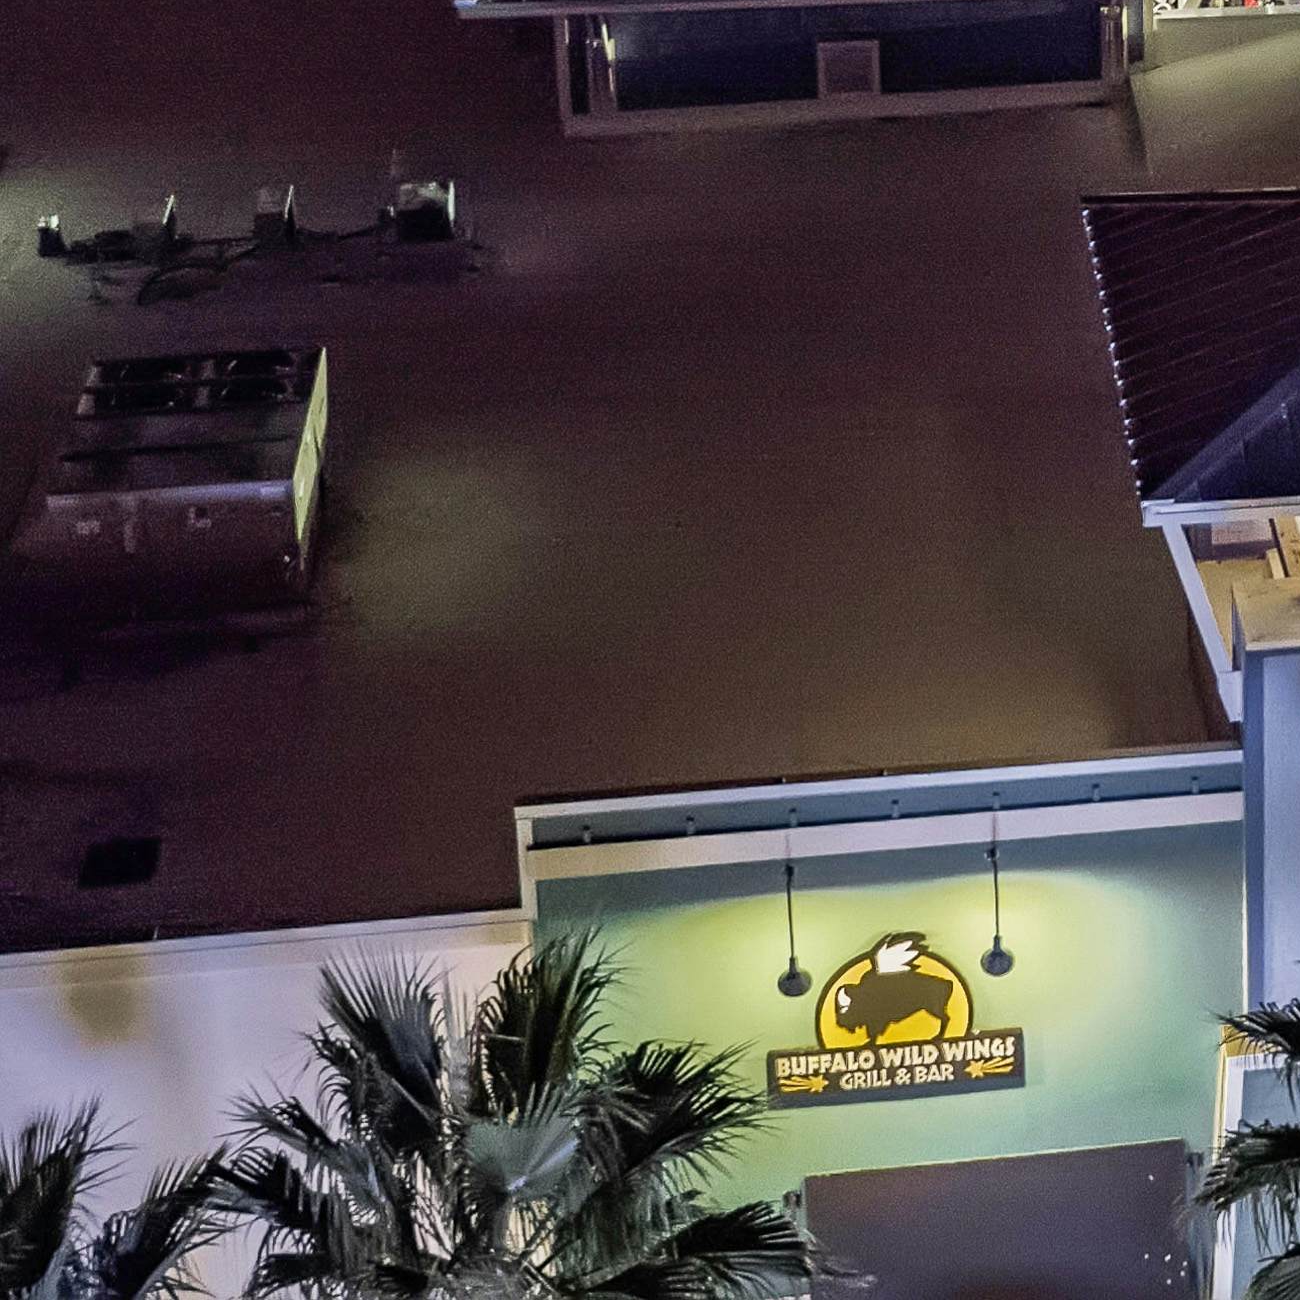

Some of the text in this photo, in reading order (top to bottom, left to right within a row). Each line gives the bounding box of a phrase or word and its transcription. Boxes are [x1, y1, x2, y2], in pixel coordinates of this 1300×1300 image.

[776, 1036, 1016, 1077] BUFFALO WILD WINGS
[840, 1063, 954, 1092] GRILL & BAR
